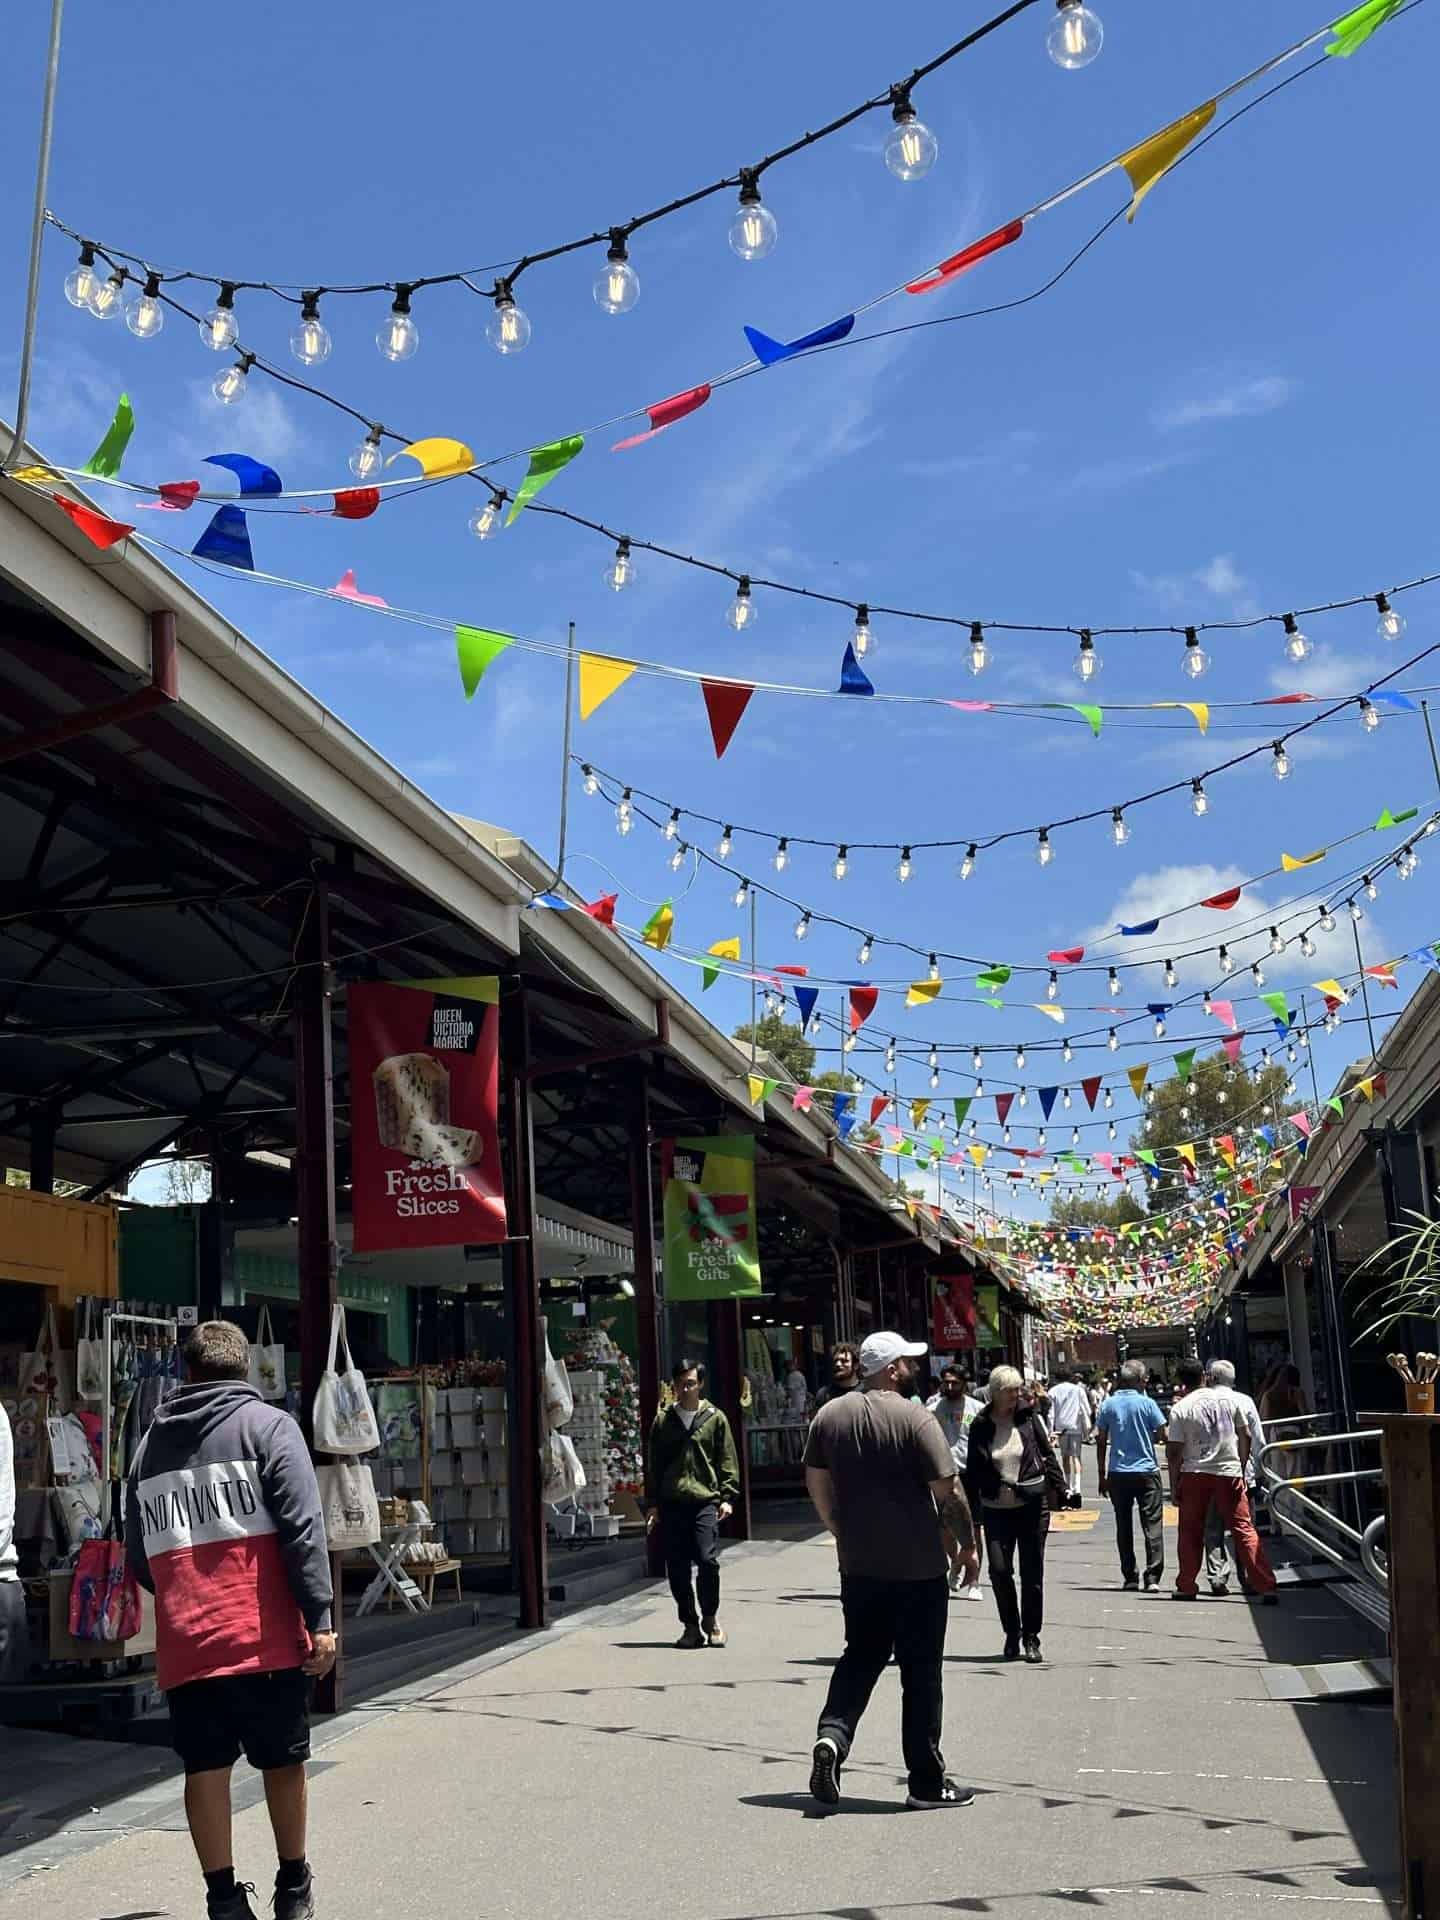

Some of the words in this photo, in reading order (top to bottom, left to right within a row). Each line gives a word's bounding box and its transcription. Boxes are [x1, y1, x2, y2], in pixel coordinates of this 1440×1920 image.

[433, 1008, 462, 1023] QUEEN
[433, 1021, 474, 1036] VICTORIA
[433, 1035, 468, 1049] MARKET
[384, 1166, 470, 1196] Fresh
[396, 1197, 460, 1217] Slices
[688, 1250, 737, 1268] Fresh
[696, 1267, 730, 1281] Gifts
